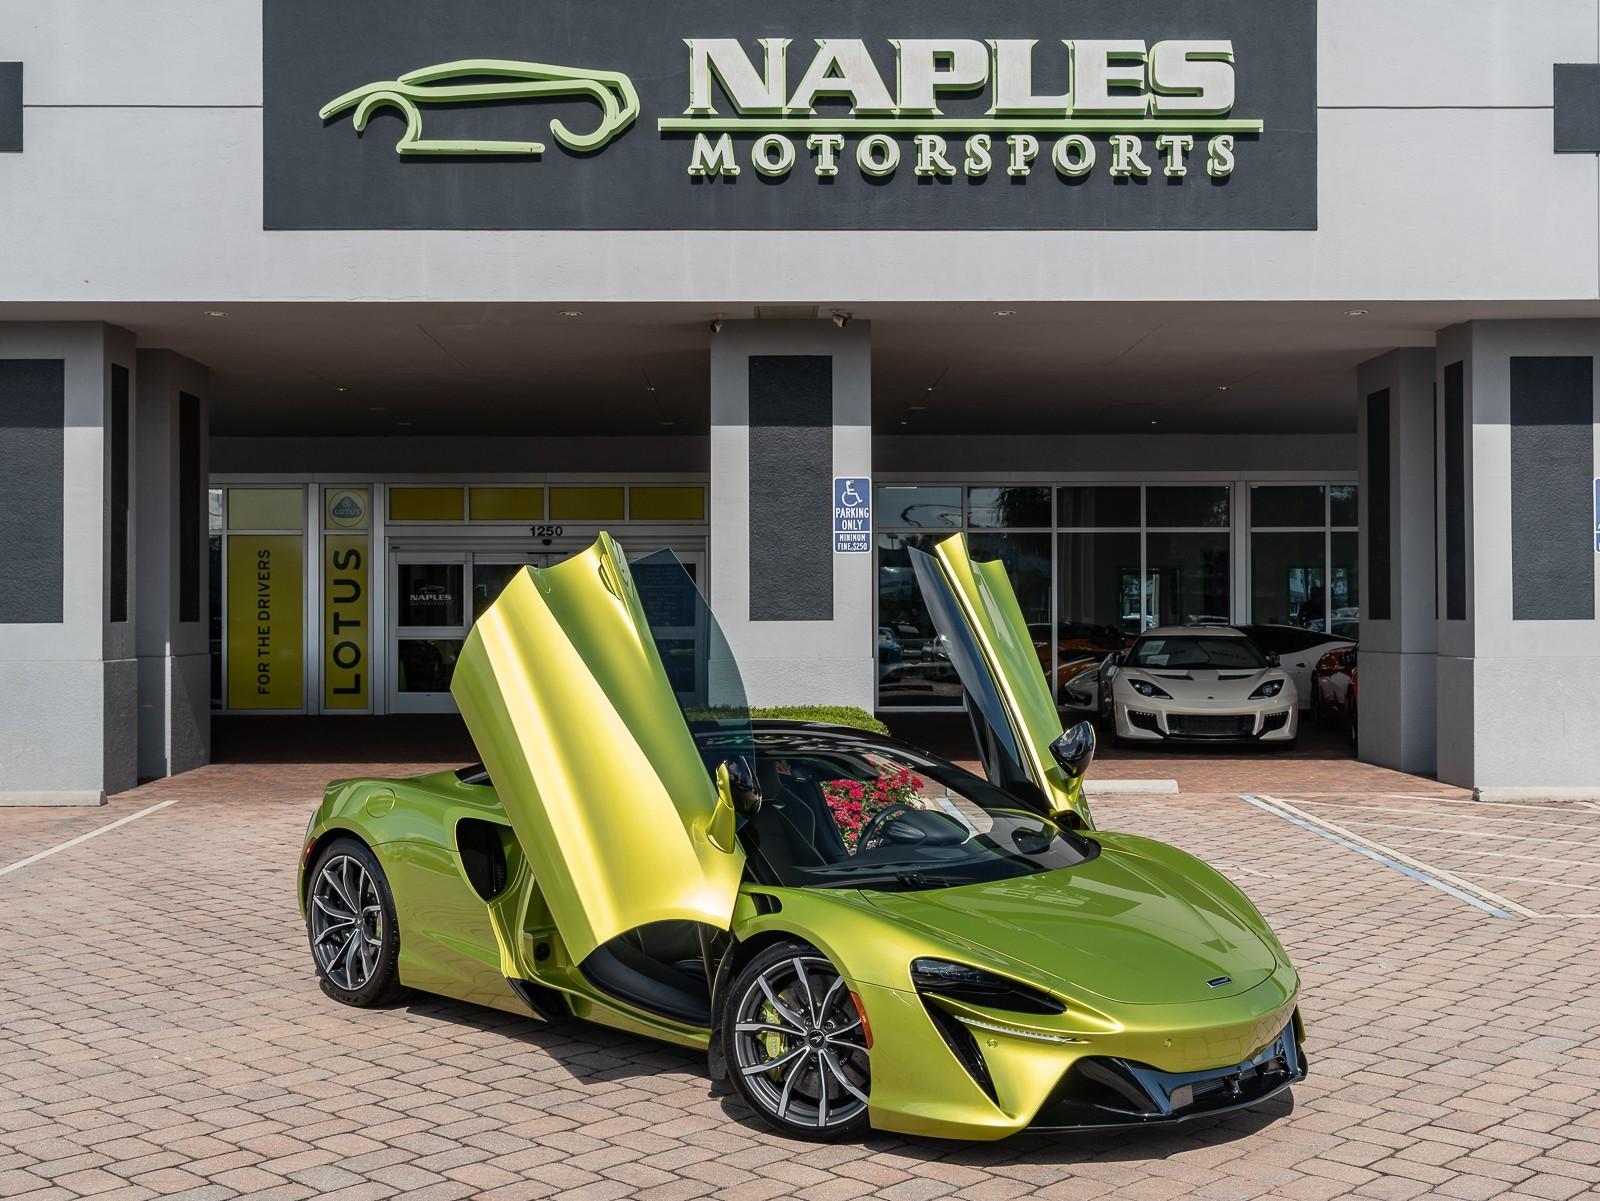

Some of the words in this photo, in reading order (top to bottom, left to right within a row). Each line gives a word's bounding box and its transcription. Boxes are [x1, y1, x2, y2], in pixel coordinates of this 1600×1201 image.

[682, 38, 1236, 116] NAPLES
[687, 133, 1236, 177] MOTORSPORTS
[835, 507, 869, 519] PARKING
[841, 519, 863, 531] ONLY
[530, 526, 563, 537] 1250
[839, 533, 866, 542] MINIMUM
[257, 549, 271, 620] DRIVERS
[409, 593, 452, 601] NAPLES
[332, 548, 361, 695] LOTUS
[257, 626, 271, 659] THE
[257, 662, 271, 695] FOR
